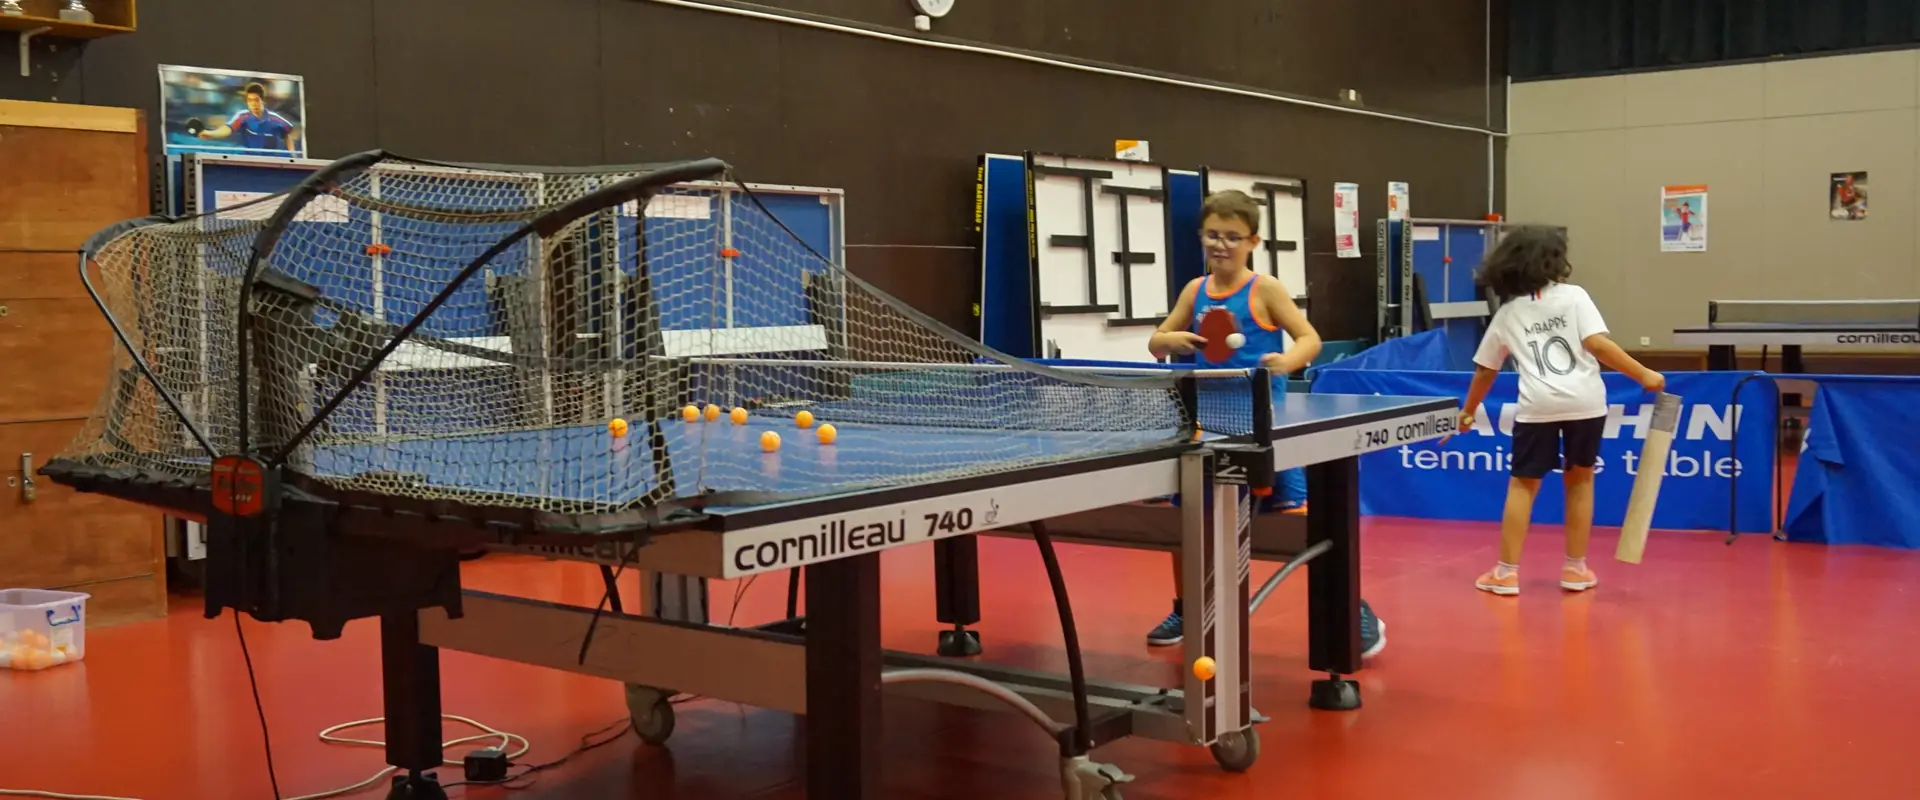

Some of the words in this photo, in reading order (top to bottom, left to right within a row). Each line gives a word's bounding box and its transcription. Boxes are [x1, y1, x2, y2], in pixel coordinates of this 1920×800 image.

[1527, 335, 1577, 377] 10
[1365, 428, 1389, 448] 740
[1396, 414, 1457, 441] cornilleau
[1622, 450, 1743, 478] tble
[734, 517, 906, 571] cornilleau
[924, 507, 973, 538] 740
